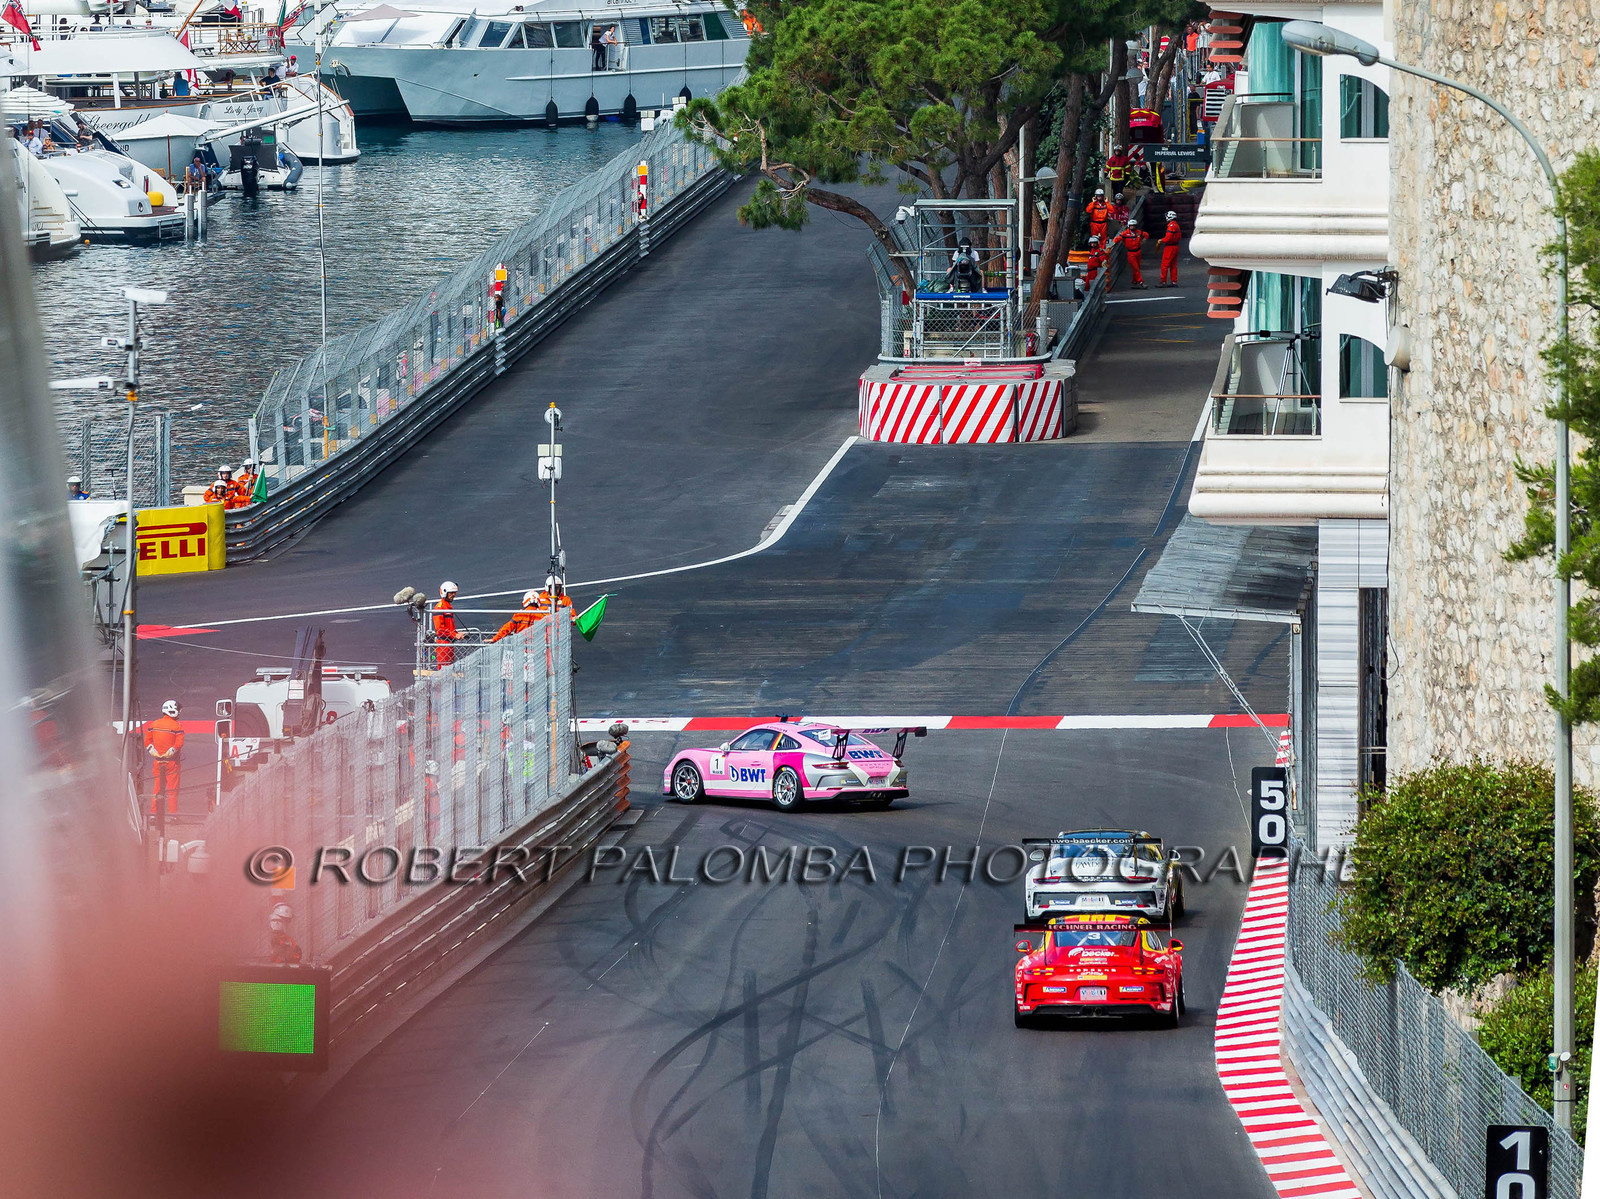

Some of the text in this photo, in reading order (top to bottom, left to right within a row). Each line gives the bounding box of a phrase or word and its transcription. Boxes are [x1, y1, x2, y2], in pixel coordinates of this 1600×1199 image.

[847, 749, 884, 760] BWT
[714, 758, 719, 770] 1
[740, 767, 766, 783] BWT
[1259, 780, 1286, 845] 50
[1087, 932, 1101, 940] 3
